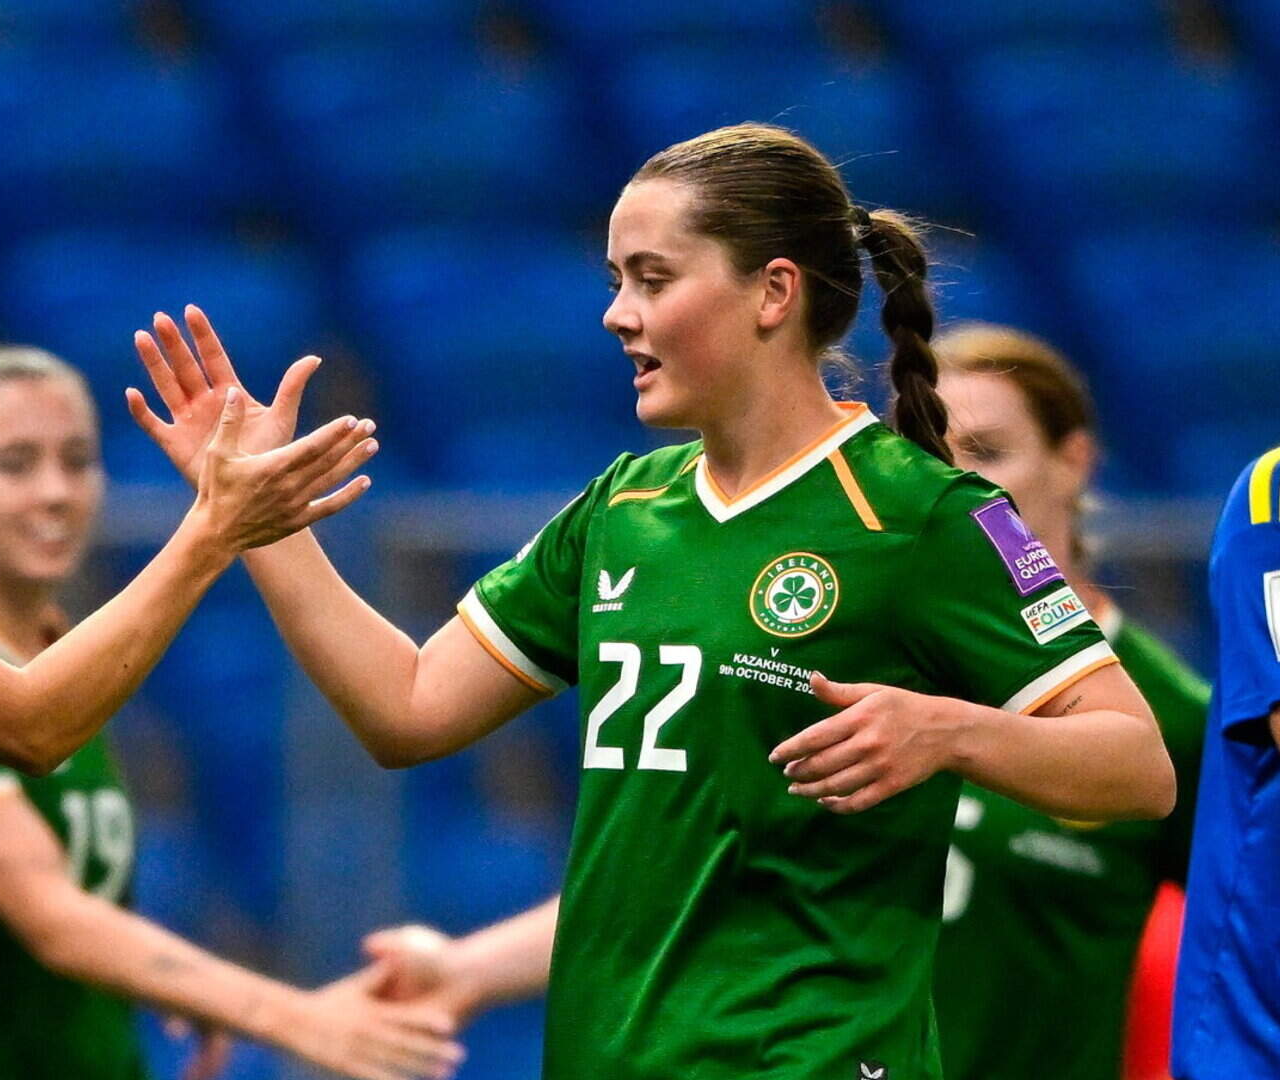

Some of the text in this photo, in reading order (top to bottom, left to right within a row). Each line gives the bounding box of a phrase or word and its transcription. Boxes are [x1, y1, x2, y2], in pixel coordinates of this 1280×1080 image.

[767, 558, 834, 591] IRELAND
[733, 653, 812, 680] KAZAKHSTAN
[735, 667, 793, 689] OCTOBER
[583, 642, 703, 773] 22
[61, 787, 134, 898] 19
